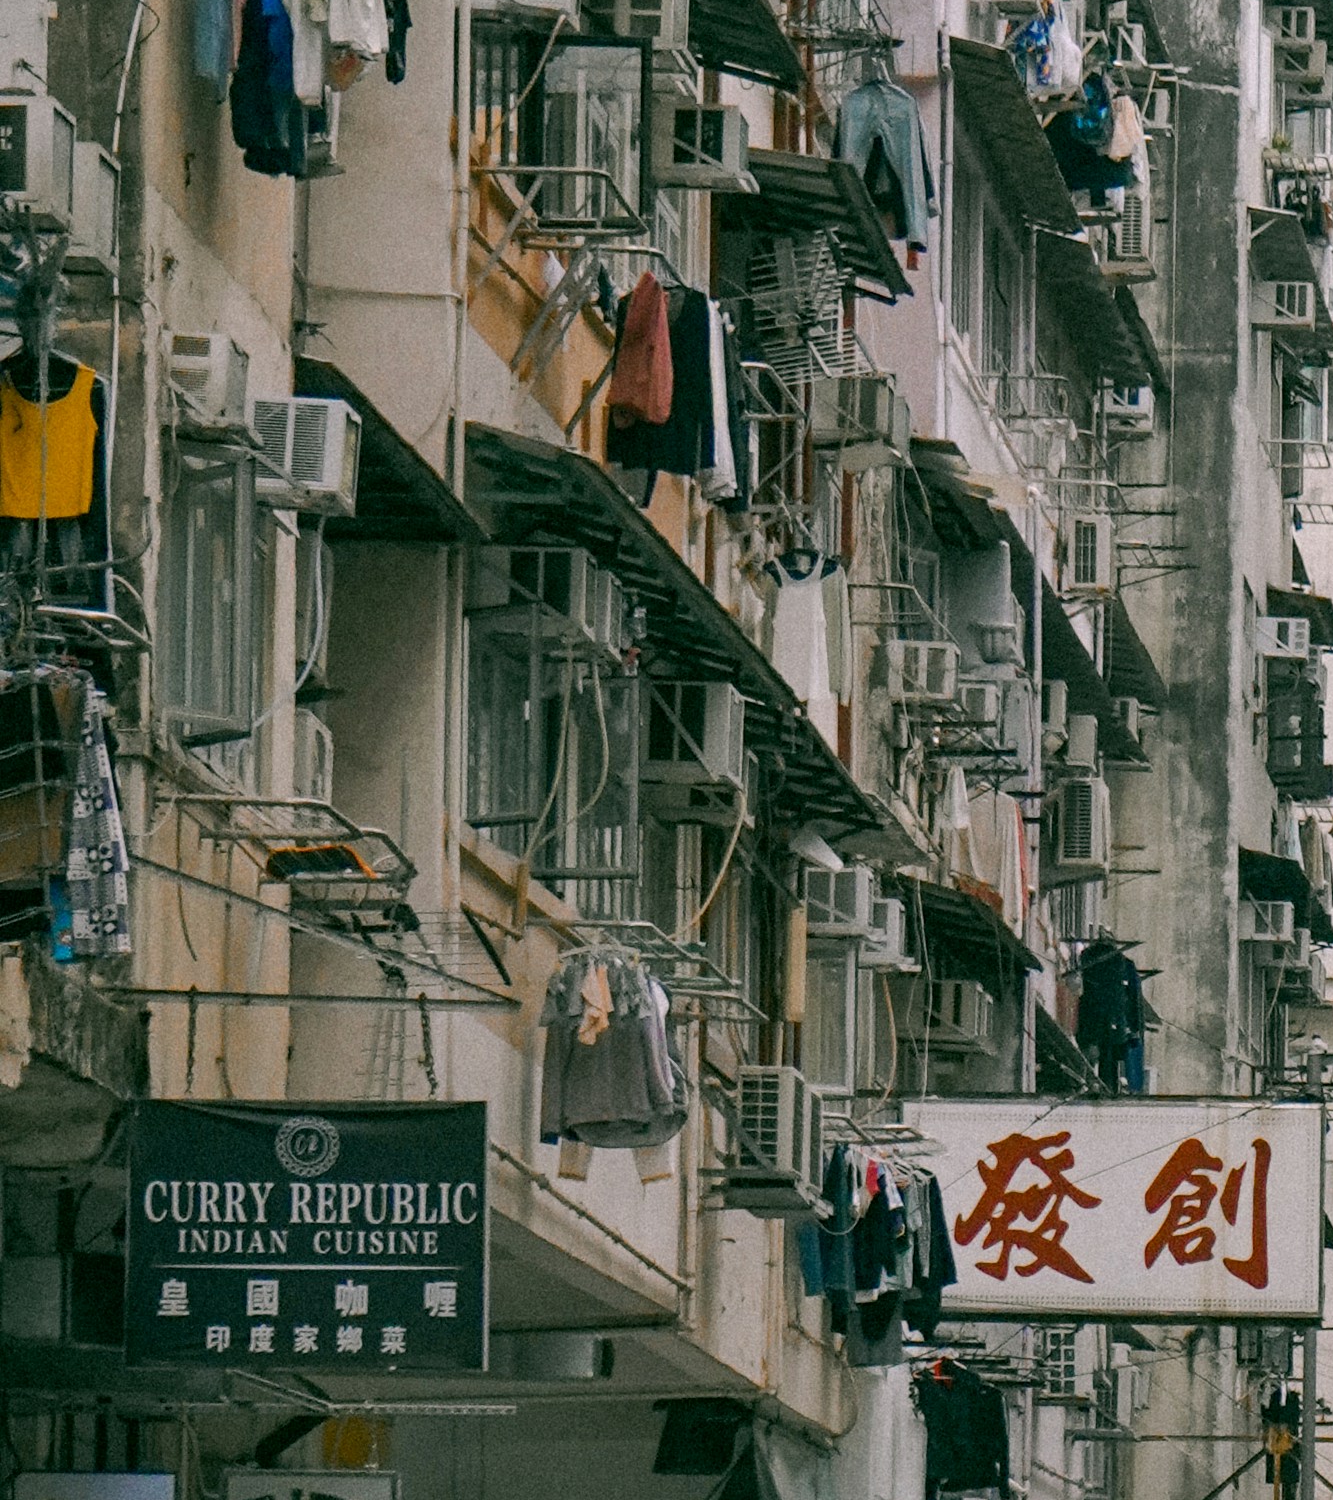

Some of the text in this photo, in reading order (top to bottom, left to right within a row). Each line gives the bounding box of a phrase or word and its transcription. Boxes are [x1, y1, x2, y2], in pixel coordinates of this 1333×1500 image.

[143, 1180, 478, 1225] CURRY REPUBLIC
[177, 1229, 439, 1255] INDIAN CUISINE
[156, 1278, 459, 1319] 皇國咖喱
[205, 1325, 408, 1354] 印度家鄉菜
